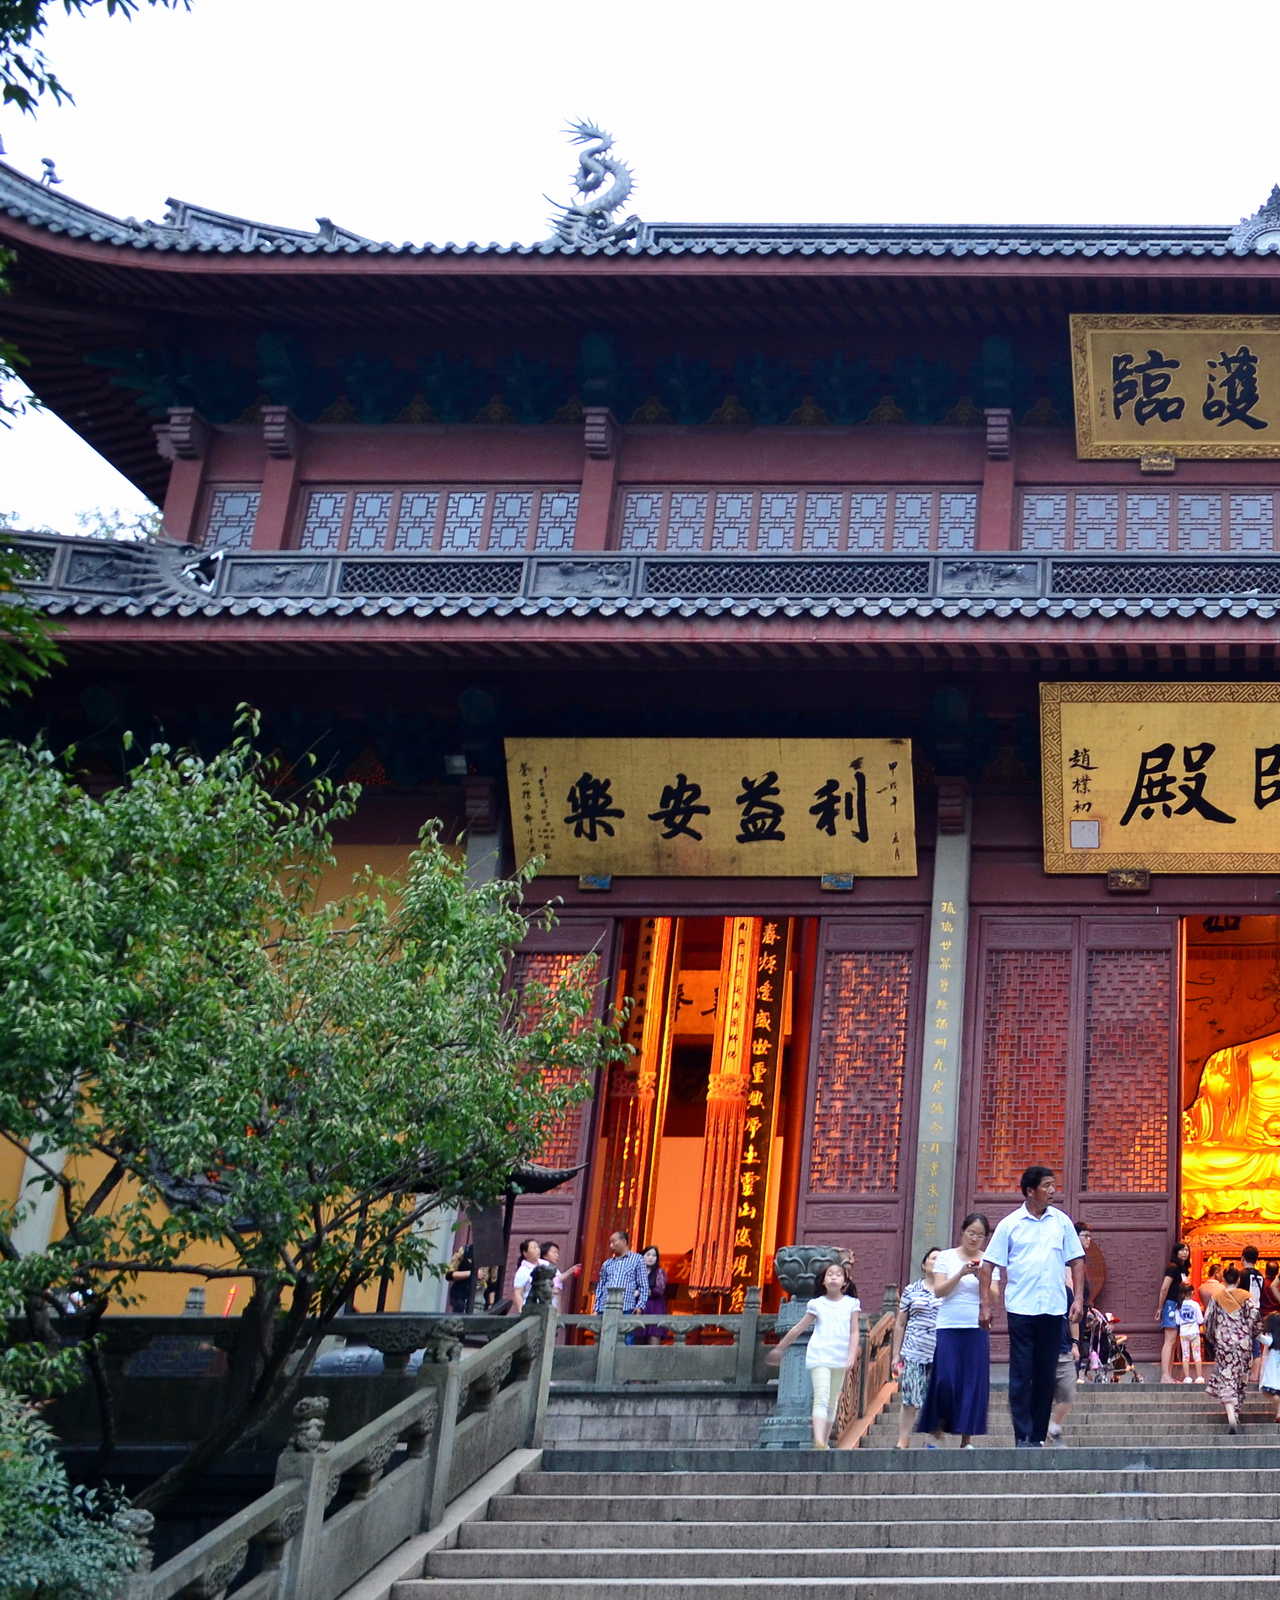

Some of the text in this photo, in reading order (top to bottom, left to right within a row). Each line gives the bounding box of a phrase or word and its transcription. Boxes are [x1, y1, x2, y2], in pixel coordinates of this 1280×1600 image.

[564, 771, 869, 843] 利益安樂
[1068, 748, 1099, 813] 趙樸初
